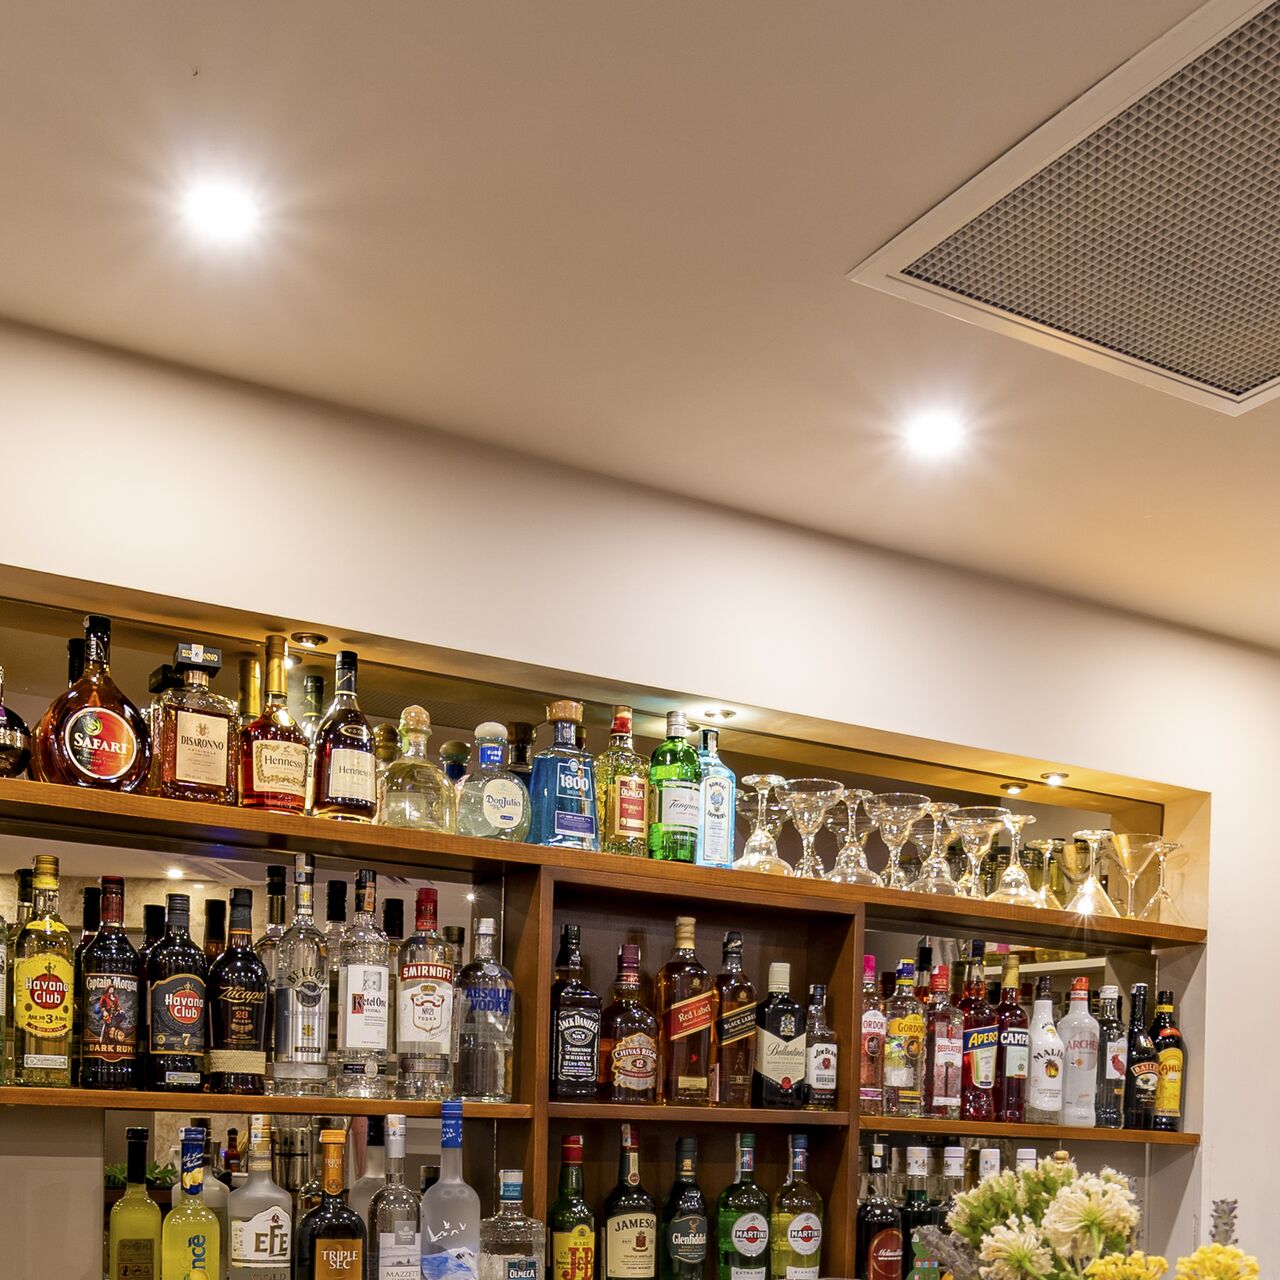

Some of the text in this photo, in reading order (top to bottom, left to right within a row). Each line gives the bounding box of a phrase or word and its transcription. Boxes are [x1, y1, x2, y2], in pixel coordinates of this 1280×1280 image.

[181, 648, 218, 661] DISNNO
[73, 733, 128, 754] SAFARI
[181, 735, 224, 750] DISARONNO
[264, 755, 305, 769] Hennessy
[560, 774, 589, 792] 1800
[403, 965, 452, 979] SMIRNOFF
[25, 977, 69, 991] Havana
[86, 976, 138, 992] Captain Morgan
[33, 991, 62, 1004] Club
[165, 993, 204, 1007] Havana
[466, 987, 512, 1002] ABSOLUT
[174, 1006, 198, 1018] Club
[471, 999, 510, 1016] VODKA
[678, 1011, 693, 1023] Red
[694, 1004, 712, 1018] Label
[45, 1014, 54, 1024] 3
[558, 1018, 575, 1031] JACK
[723, 1019, 741, 1030] BLACK
[182, 1033, 191, 1046] 7
[968, 1031, 999, 1048] APERO
[1066, 1040, 1097, 1051] ARCHE
[89, 1043, 133, 1053] DARK RUM
[615, 1048, 657, 1060] CHIVAS REGA
[766, 1042, 805, 1056] Ballantine's
[937, 1044, 962, 1053] BEEFEATER
[615, 1218, 655, 1232] JAMESO
[254, 1224, 289, 1257] EFE
[736, 1230, 767, 1239] MARTINI
[321, 1250, 359, 1262] TRIPLE
[329, 1258, 352, 1269] SEC
[562, 1247, 593, 1280] J&B
[386, 1270, 419, 1278] MAZZETT
[509, 1269, 535, 1279] OLMECA
